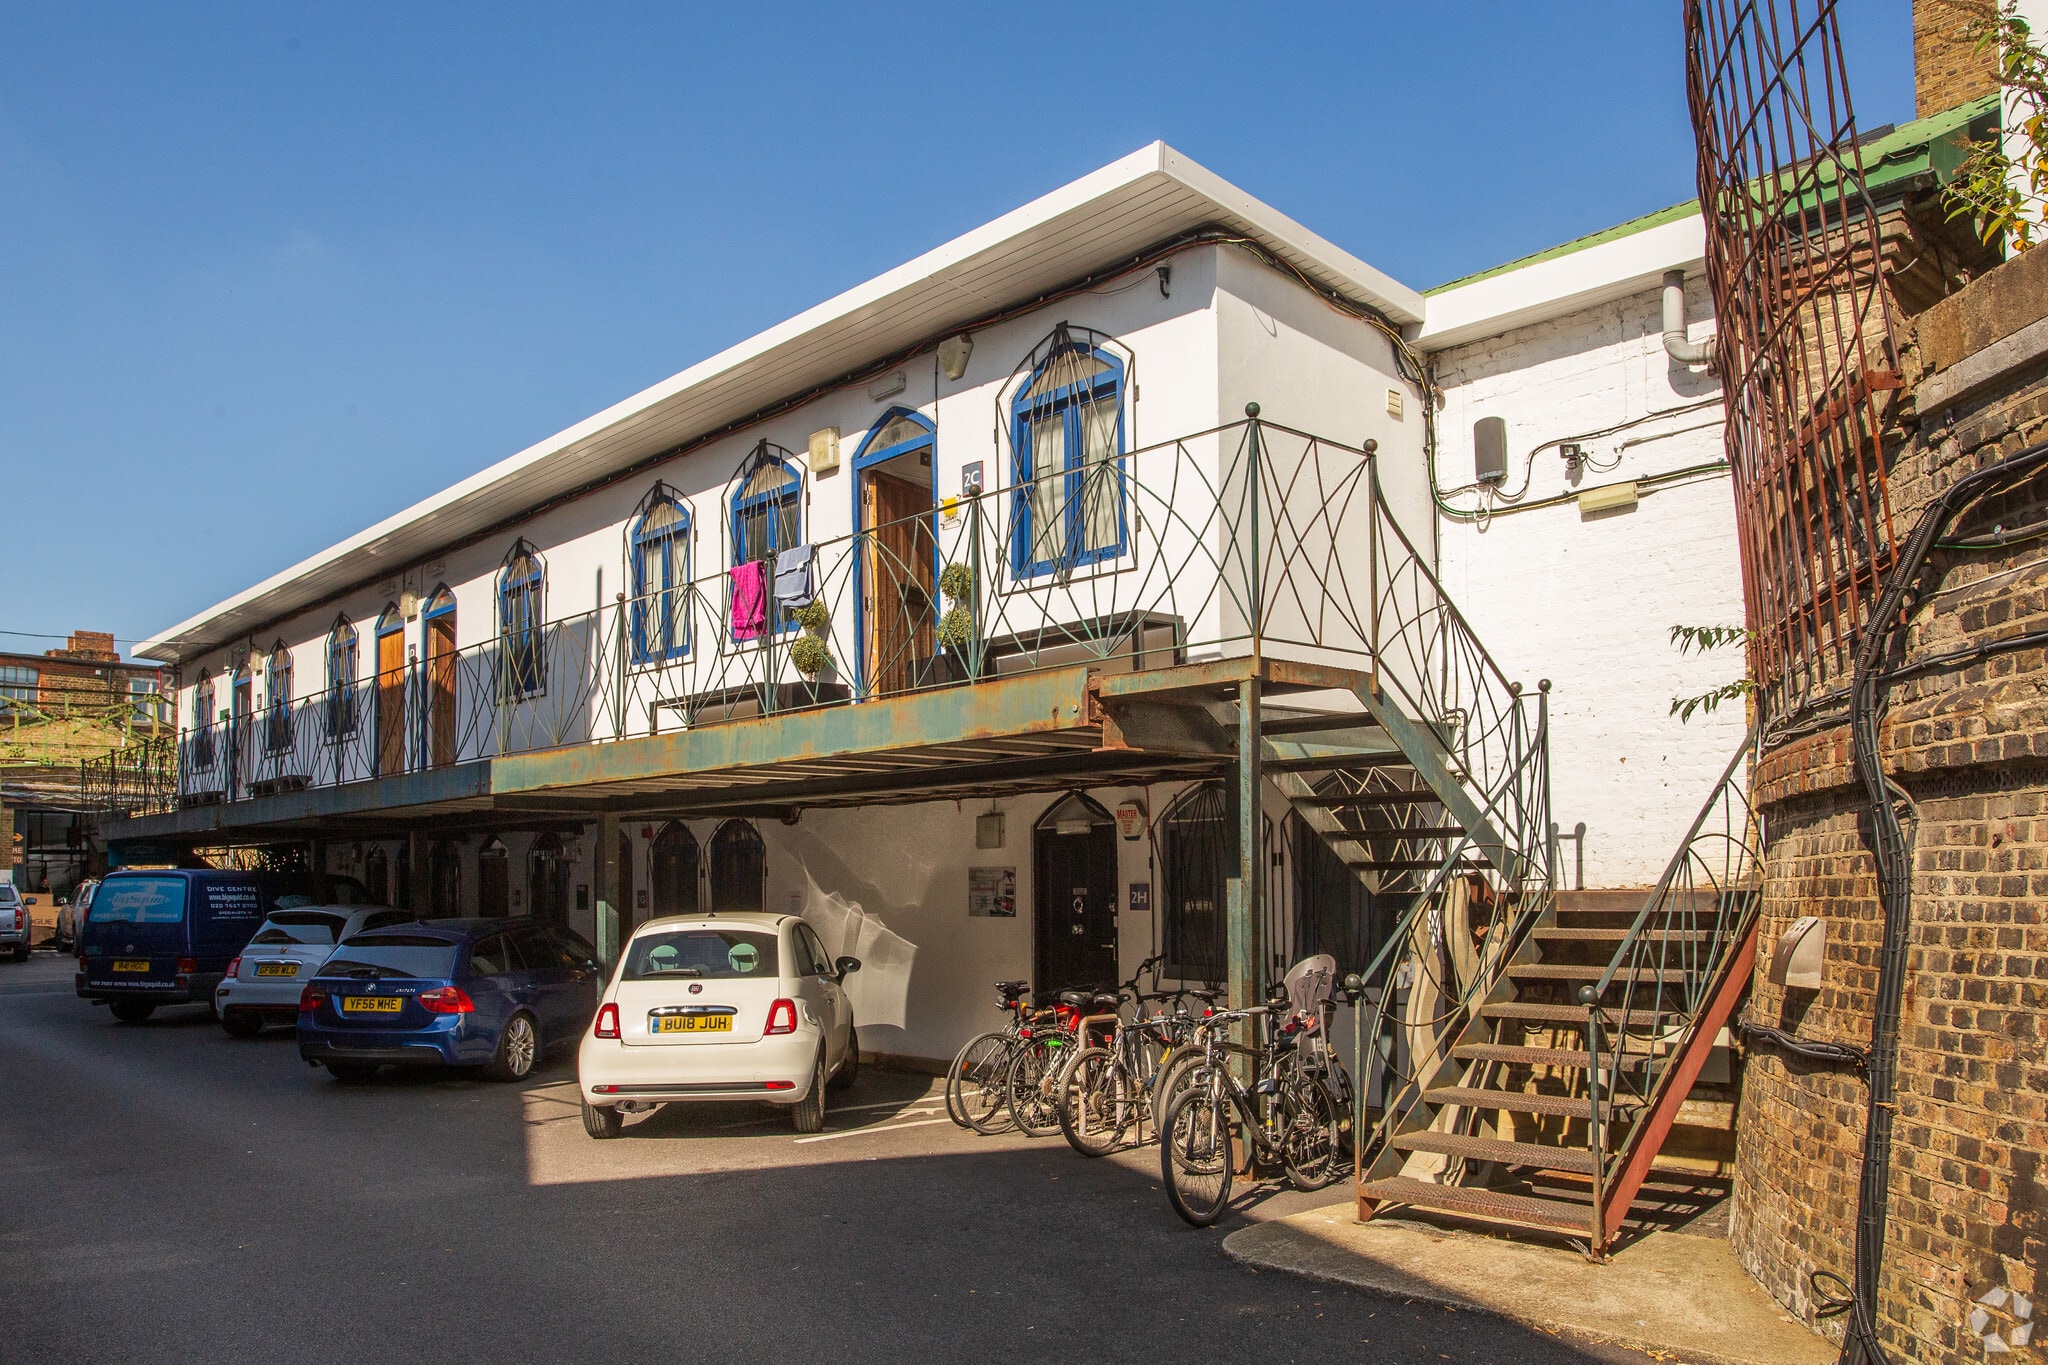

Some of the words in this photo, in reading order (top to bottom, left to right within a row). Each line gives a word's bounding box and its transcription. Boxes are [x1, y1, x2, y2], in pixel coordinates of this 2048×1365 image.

[964, 470, 980, 487] 2C
[163, 674, 176, 690] 2
[1117, 809, 1137, 819] MASTER
[1131, 891, 1147, 904] 2H
[259, 966, 279, 974] GF66
[350, 999, 375, 1009] YF56
[377, 999, 397, 1010] MHE
[664, 1017, 695, 1030] BU18
[699, 1017, 727, 1029] JUH
